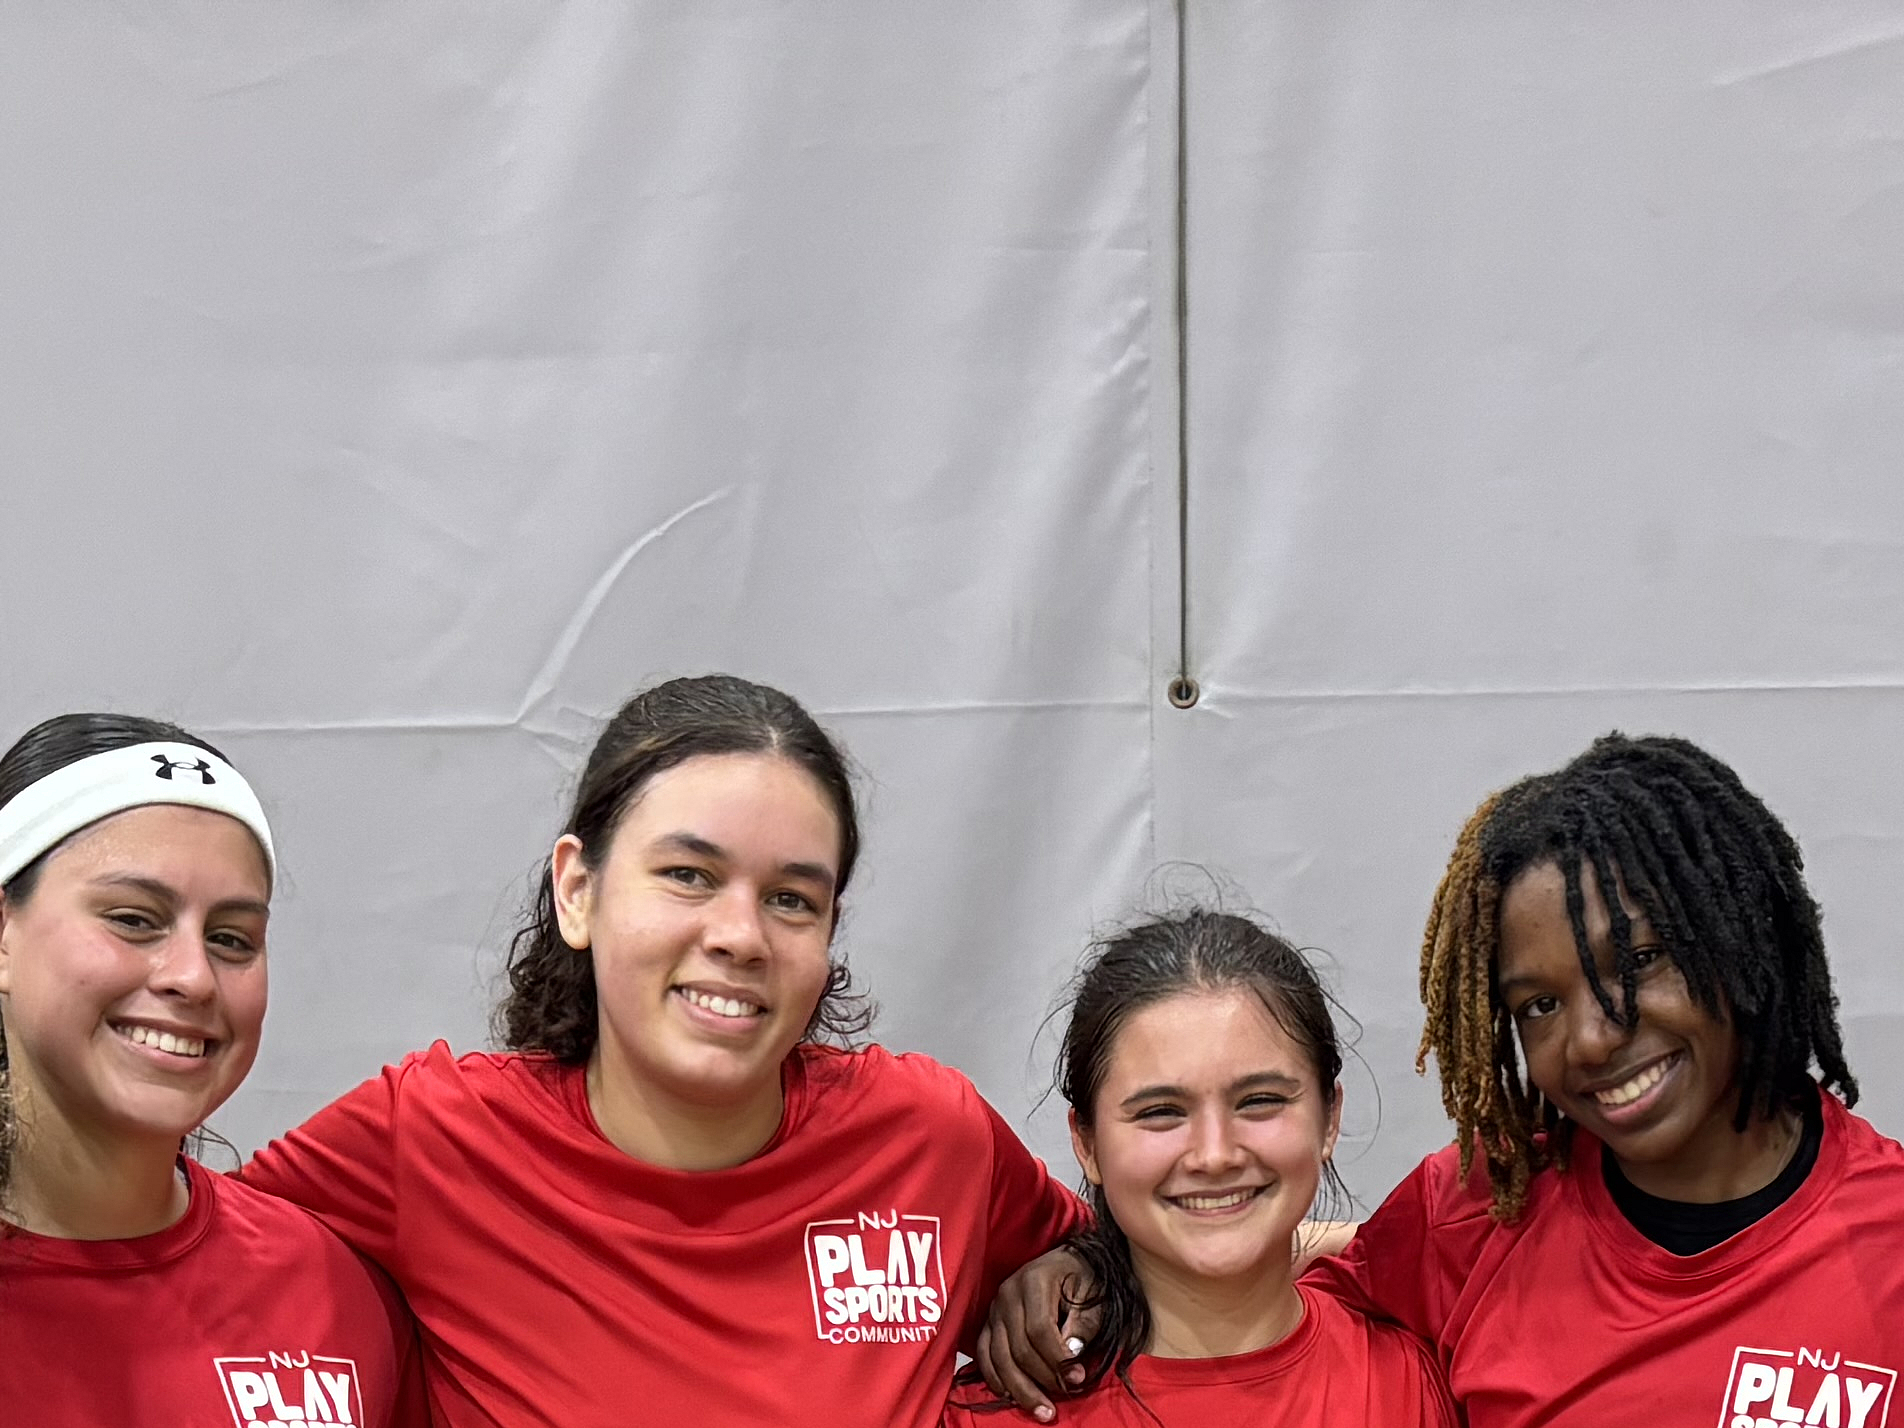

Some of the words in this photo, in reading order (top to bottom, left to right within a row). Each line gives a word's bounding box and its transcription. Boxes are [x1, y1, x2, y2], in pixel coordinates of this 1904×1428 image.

[858, 1209, 898, 1231] NJ
[814, 1230, 933, 1288] PLAY
[823, 1285, 941, 1325] SPORTS
[268, 1350, 310, 1369] NJ
[1797, 1346, 1840, 1371] NJ
[229, 1368, 353, 1424] PLAY
